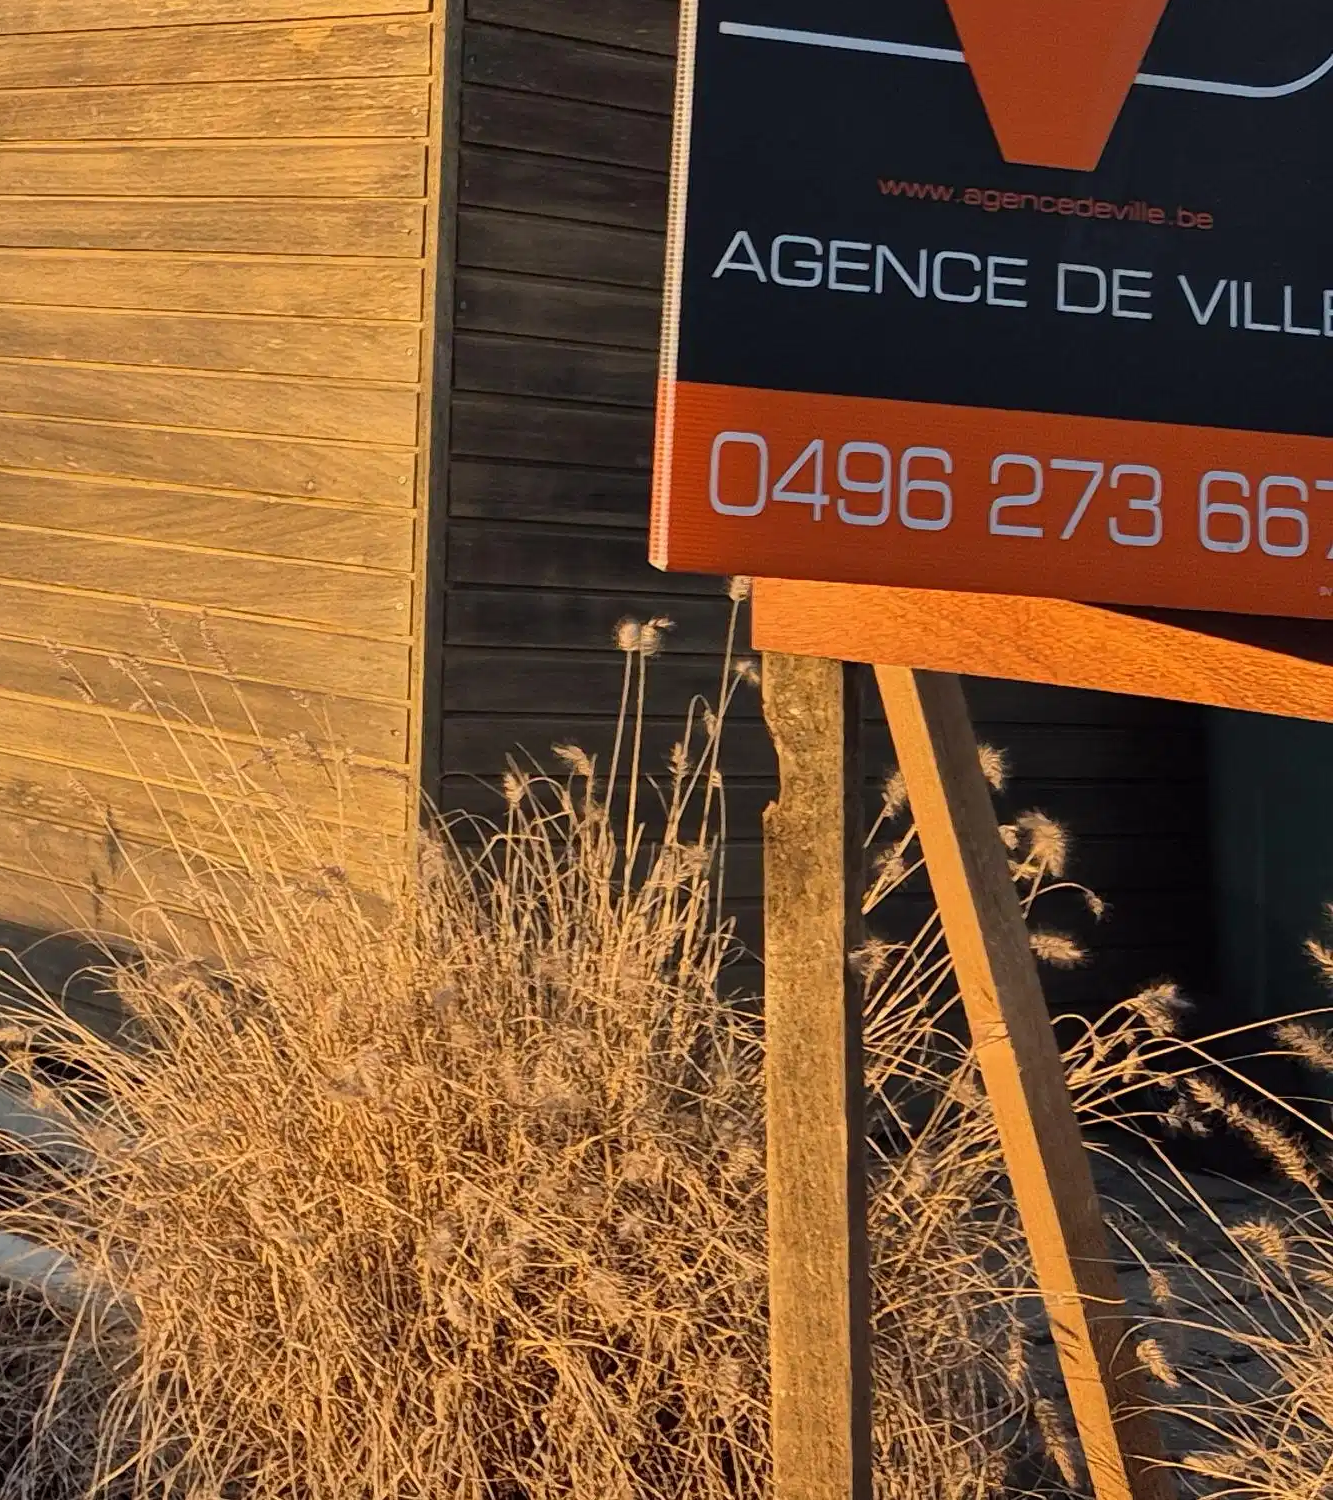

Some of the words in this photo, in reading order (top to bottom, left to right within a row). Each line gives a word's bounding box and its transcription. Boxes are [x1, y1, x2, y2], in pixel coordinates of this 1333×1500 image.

[876, 177, 1214, 231] www.agencedeville.be
[711, 229, 1029, 309] AGENCE
[1056, 262, 1153, 321] DE
[1176, 274, 1333, 338] VILL
[708, 430, 954, 532] 0496
[988, 453, 1163, 548] 273
